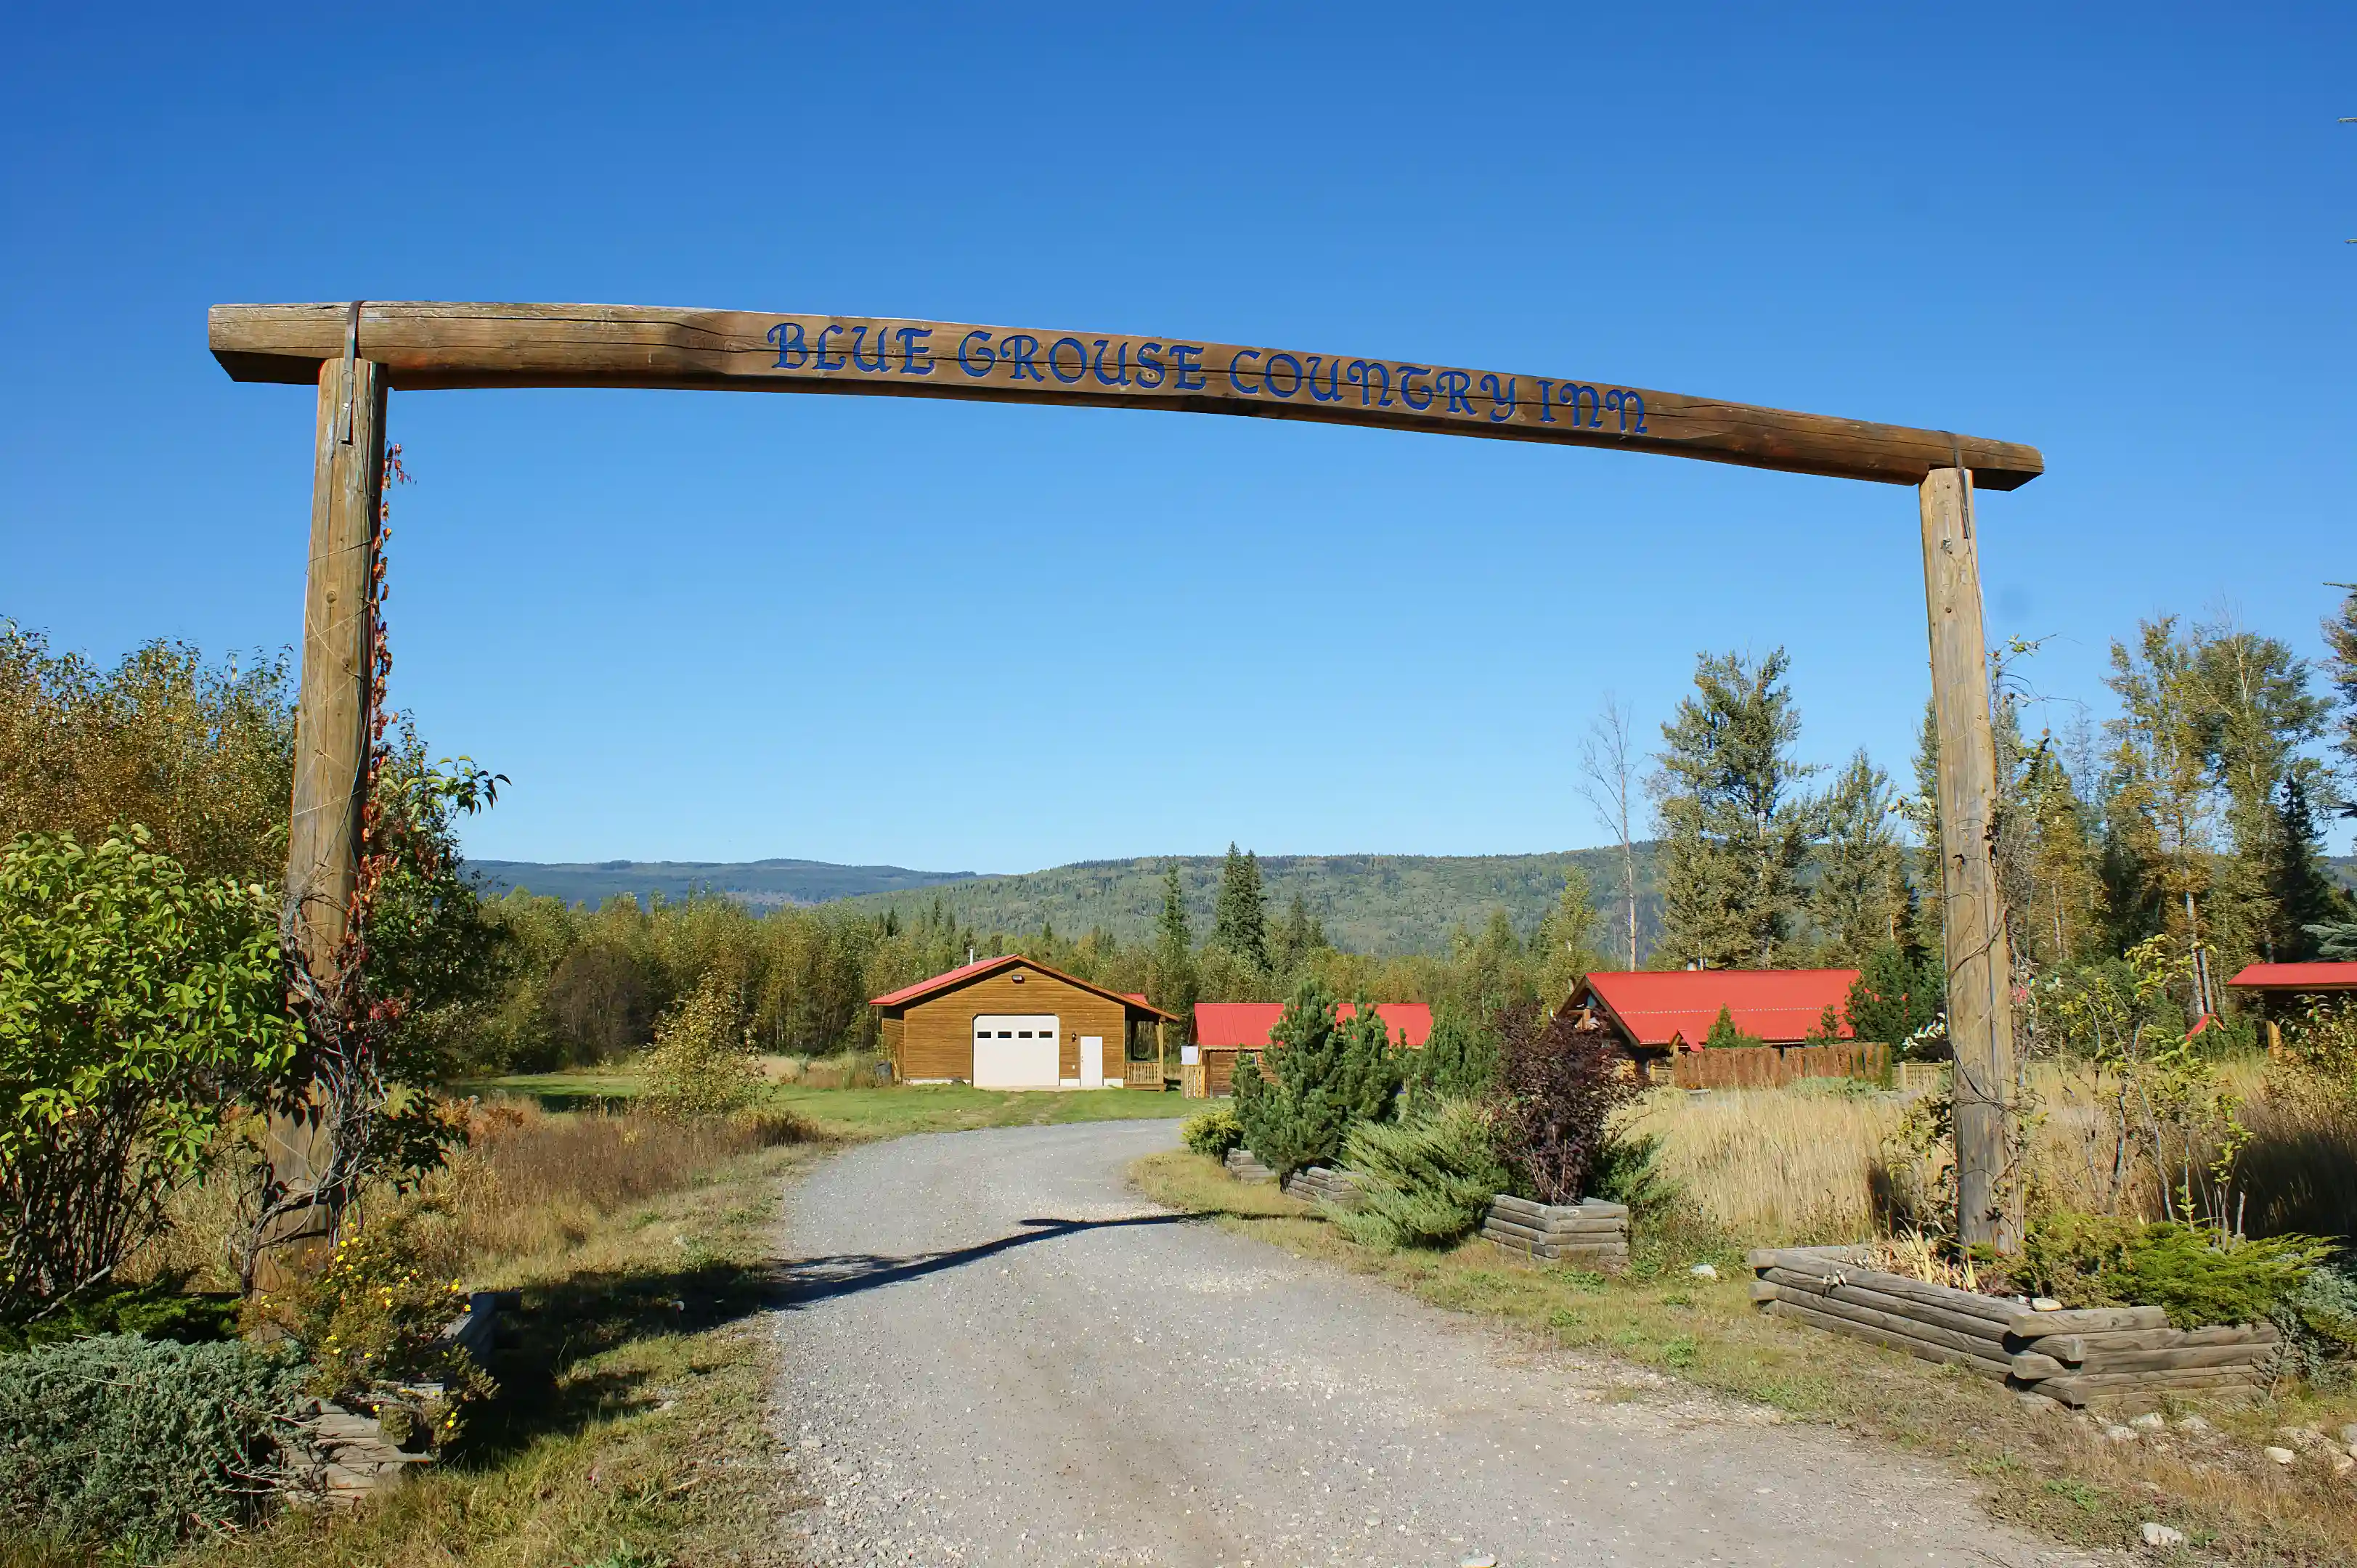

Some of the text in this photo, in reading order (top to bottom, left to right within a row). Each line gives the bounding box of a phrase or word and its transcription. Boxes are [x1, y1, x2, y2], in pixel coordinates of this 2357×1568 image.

[768, 322, 1648, 435] BLUE GROUSE COUNTRY INN
